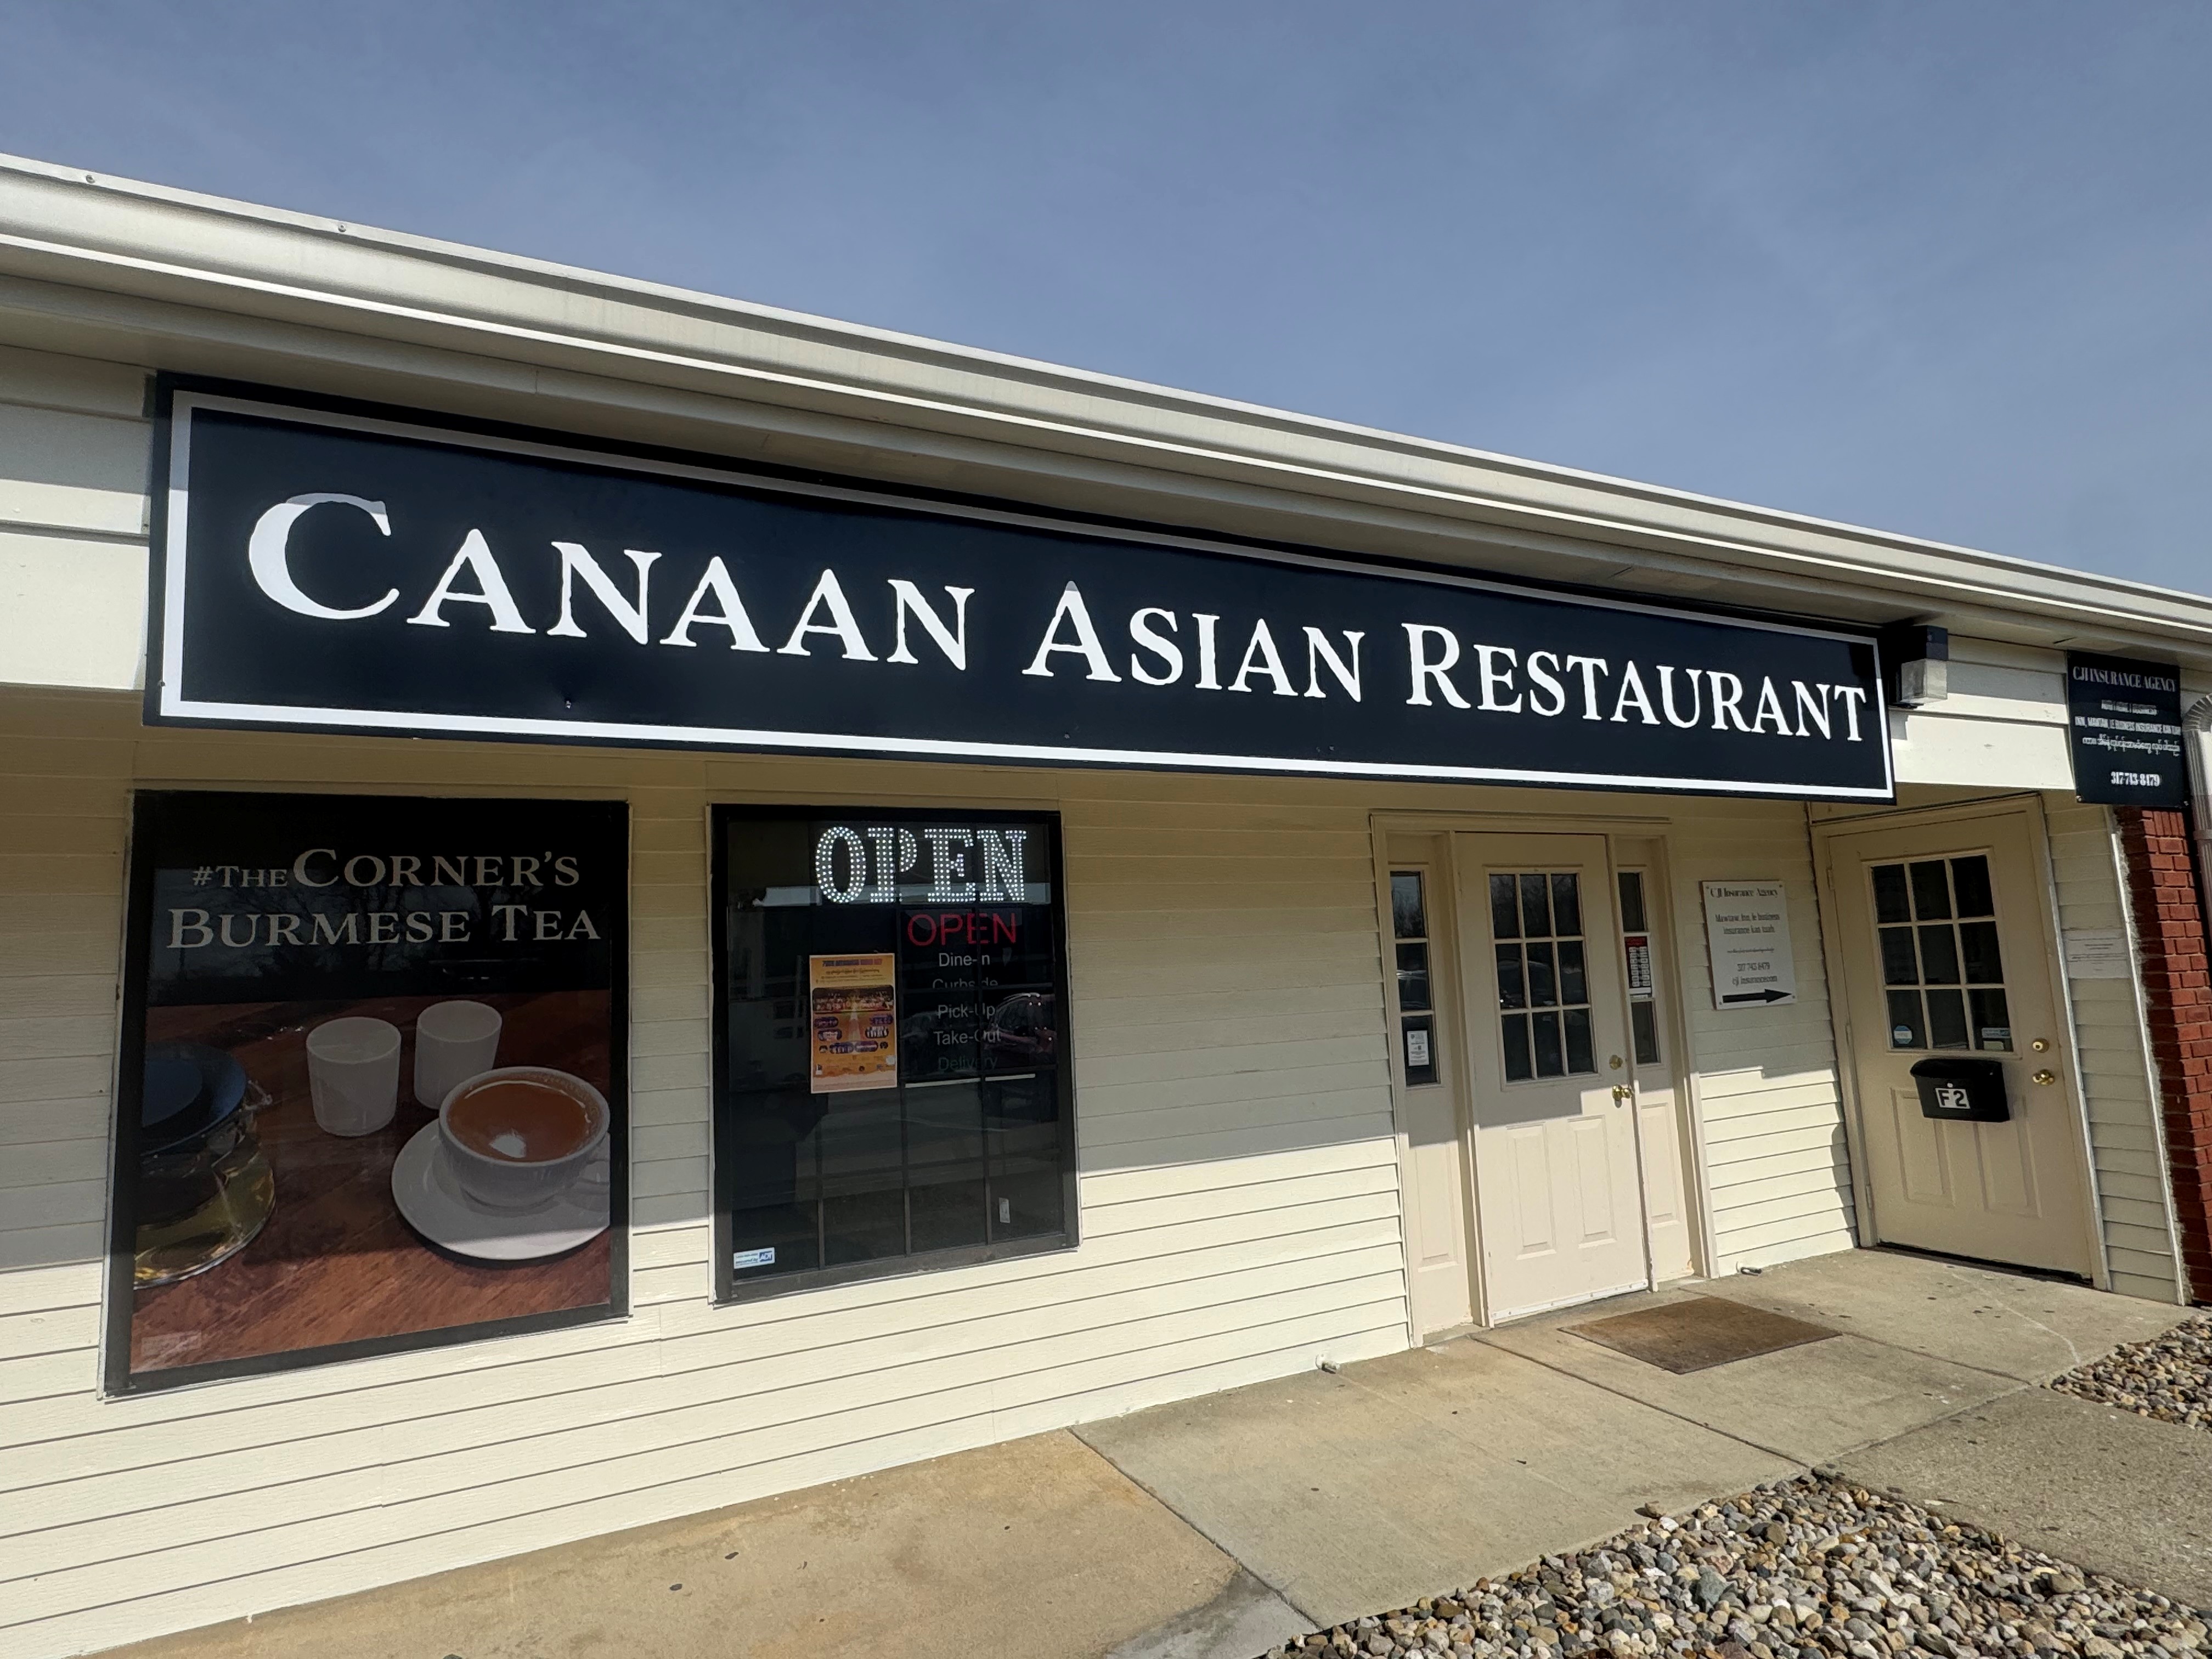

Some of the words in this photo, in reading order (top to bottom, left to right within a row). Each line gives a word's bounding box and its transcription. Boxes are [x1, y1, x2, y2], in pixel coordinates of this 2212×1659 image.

[249, 493, 974, 670] CANAAN
[1023, 580, 1365, 702] ASIAN
[1401, 622, 1867, 742] RESTAURANT
[2089, 668, 2141, 687] INSURANCE
[2143, 676, 2176, 692] AGENCY
[815, 826, 1028, 904] OPEN
[1724, 888, 1754, 897] Insurance
[1757, 888, 1778, 898] Agency
[167, 908, 472, 949] BURMESE
[492, 904, 601, 941] TEA
[907, 913, 1016, 947] OPEN
[939, 952, 990, 967] Dine-n
